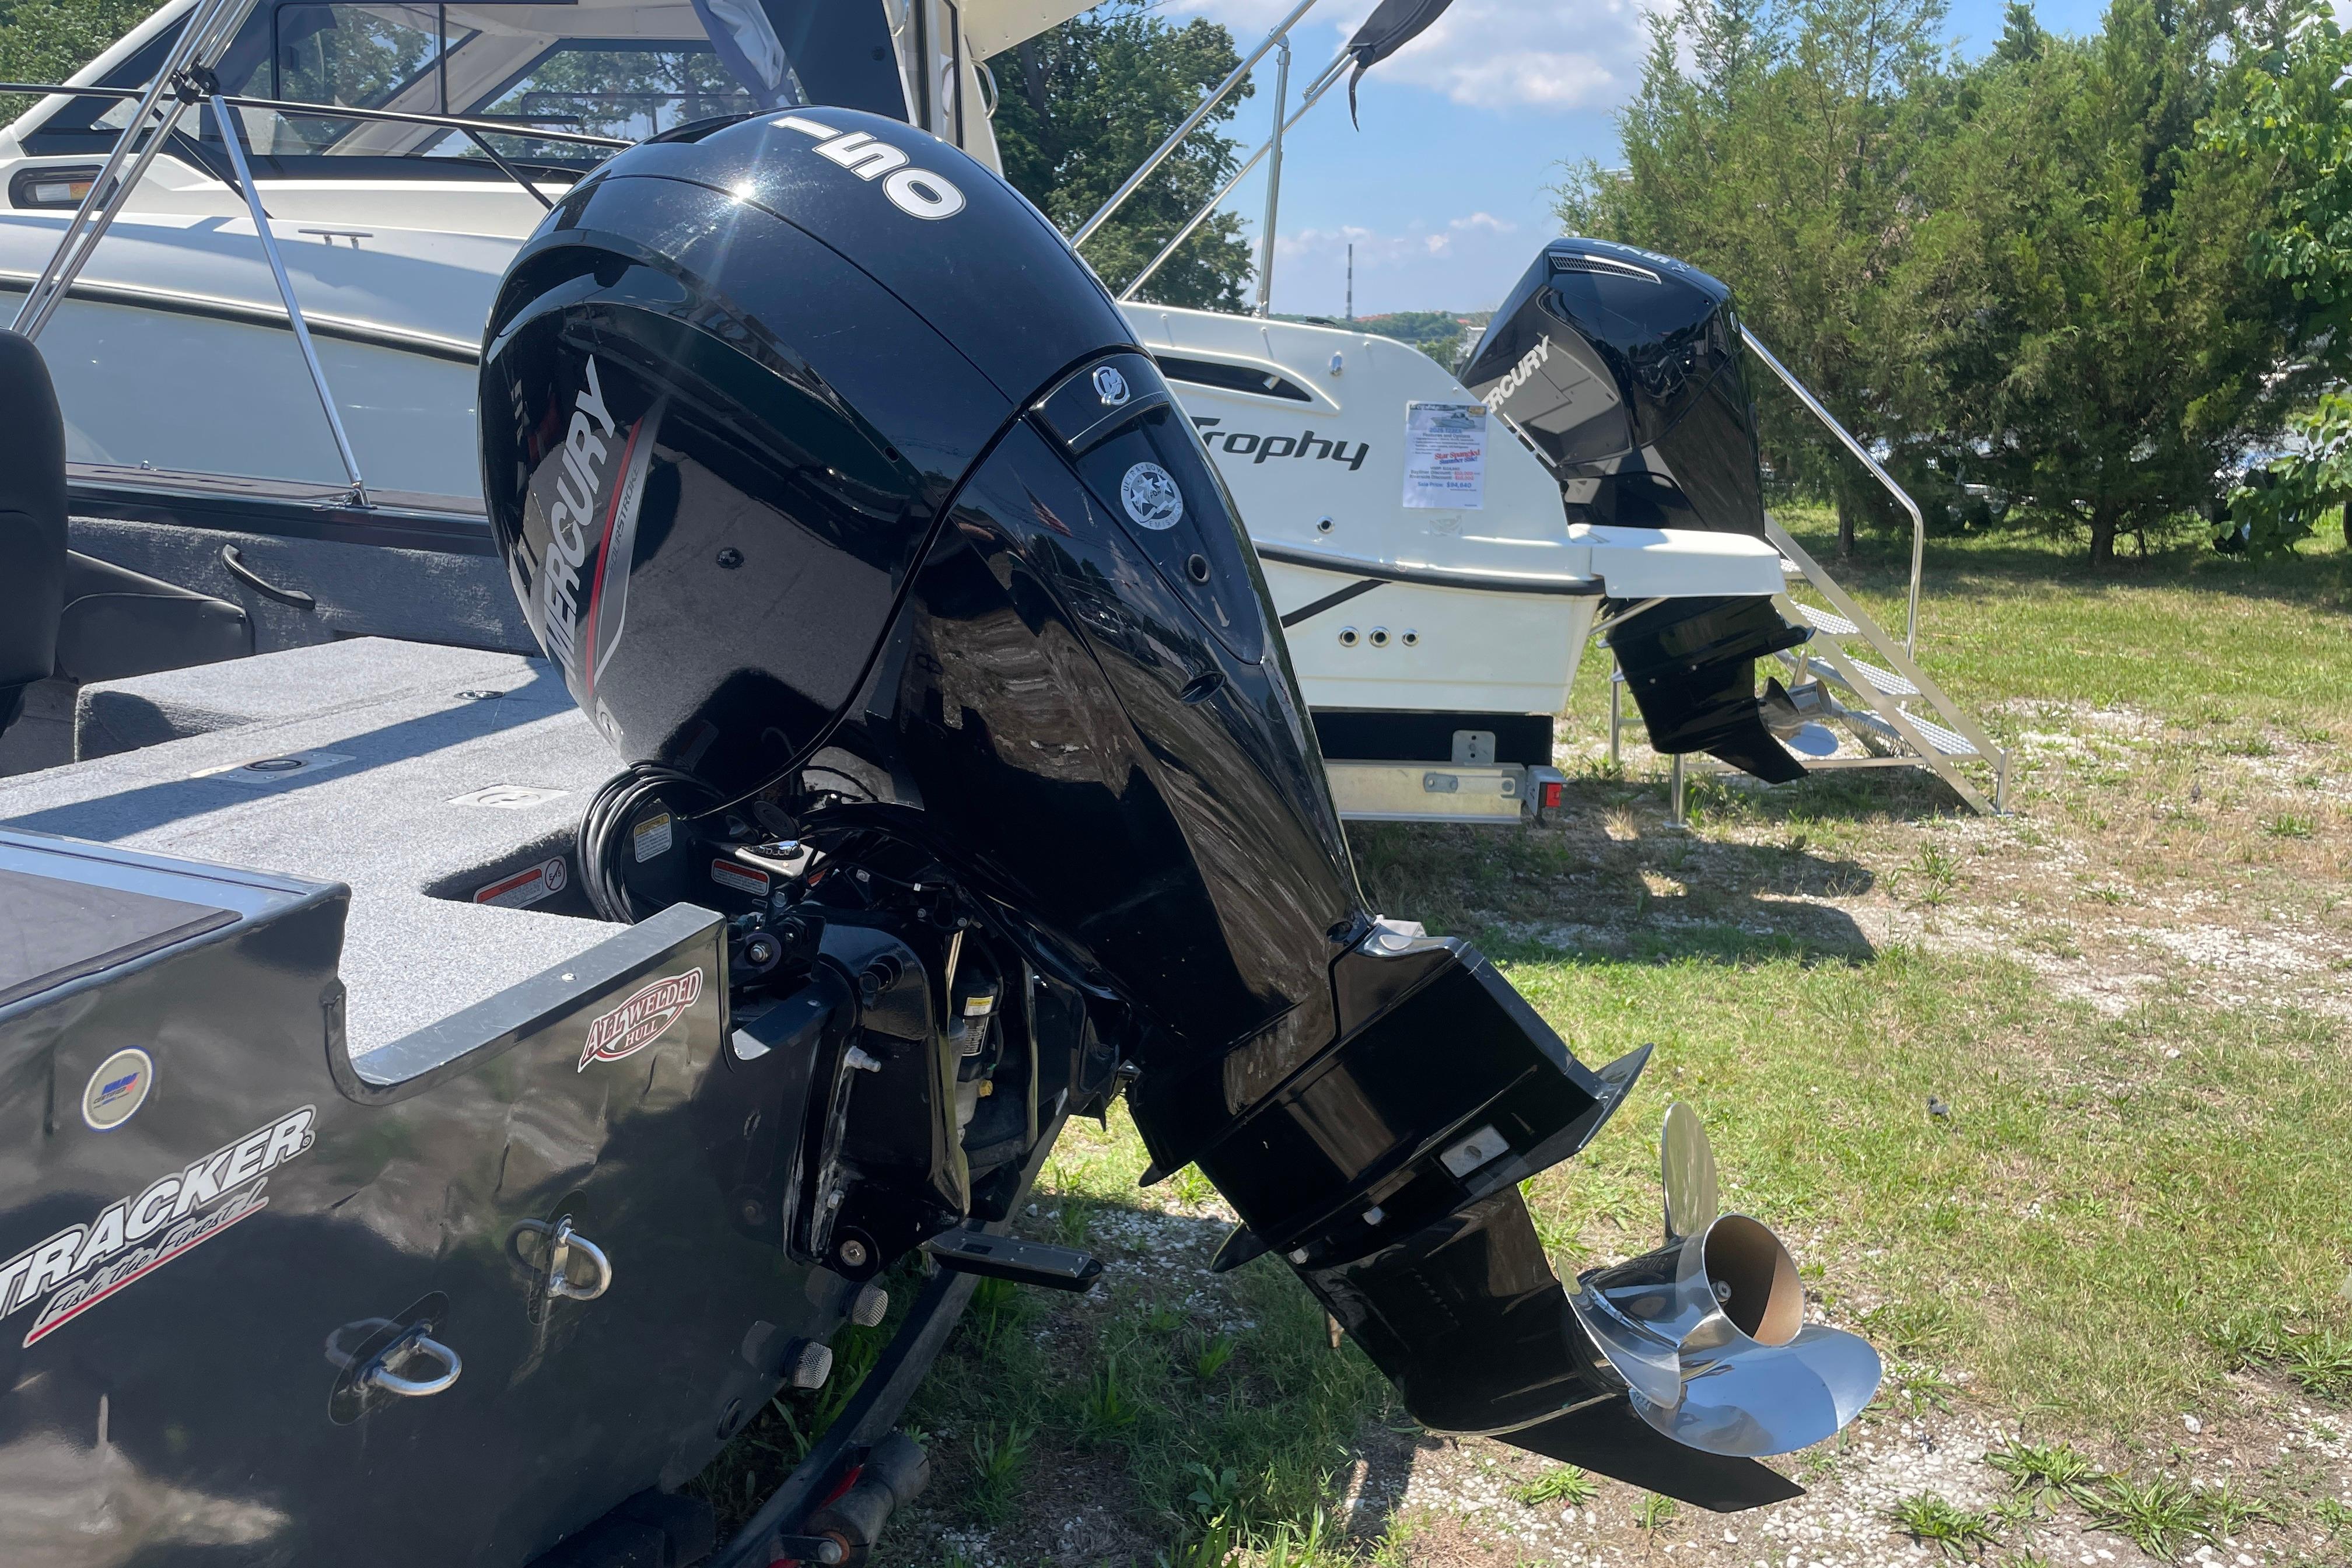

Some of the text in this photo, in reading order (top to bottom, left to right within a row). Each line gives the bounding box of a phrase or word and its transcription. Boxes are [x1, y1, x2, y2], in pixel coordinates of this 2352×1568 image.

[768, 116, 967, 220] 150
[1592, 241, 1670, 263] 175
[1450, 449, 1480, 459] Spangled
[543, 354, 615, 683] MERCURY
[608, 461, 640, 575] FOURSTROKE
[582, 972, 701, 1061] ALL WELDED
[624, 1020, 658, 1048] HULL
[38, 1272, 106, 1325] Fish
[110, 1252, 150, 1283] the
